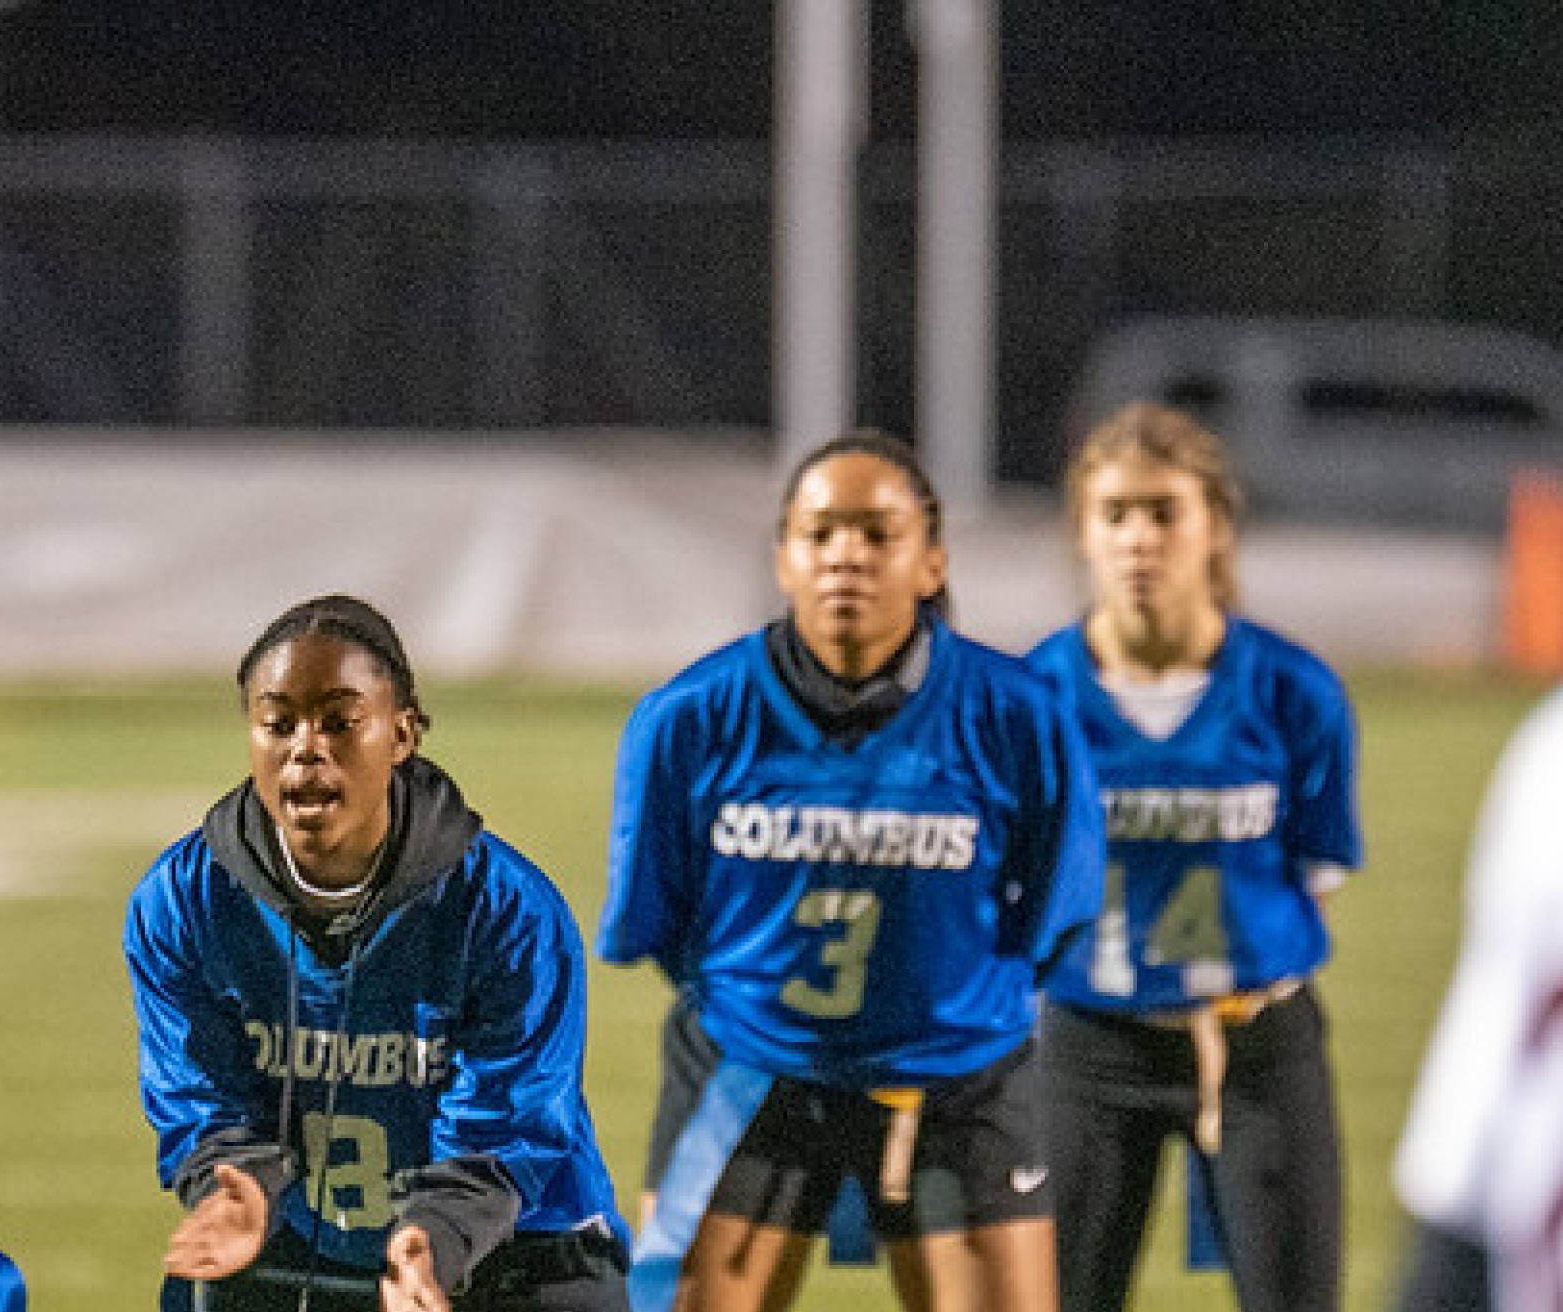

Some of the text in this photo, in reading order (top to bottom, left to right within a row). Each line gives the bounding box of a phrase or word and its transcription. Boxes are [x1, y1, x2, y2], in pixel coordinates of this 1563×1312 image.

[780, 889, 883, 1018] 3
[1090, 864, 1235, 996] 14
[245, 1019, 448, 1088] OLUMBUS
